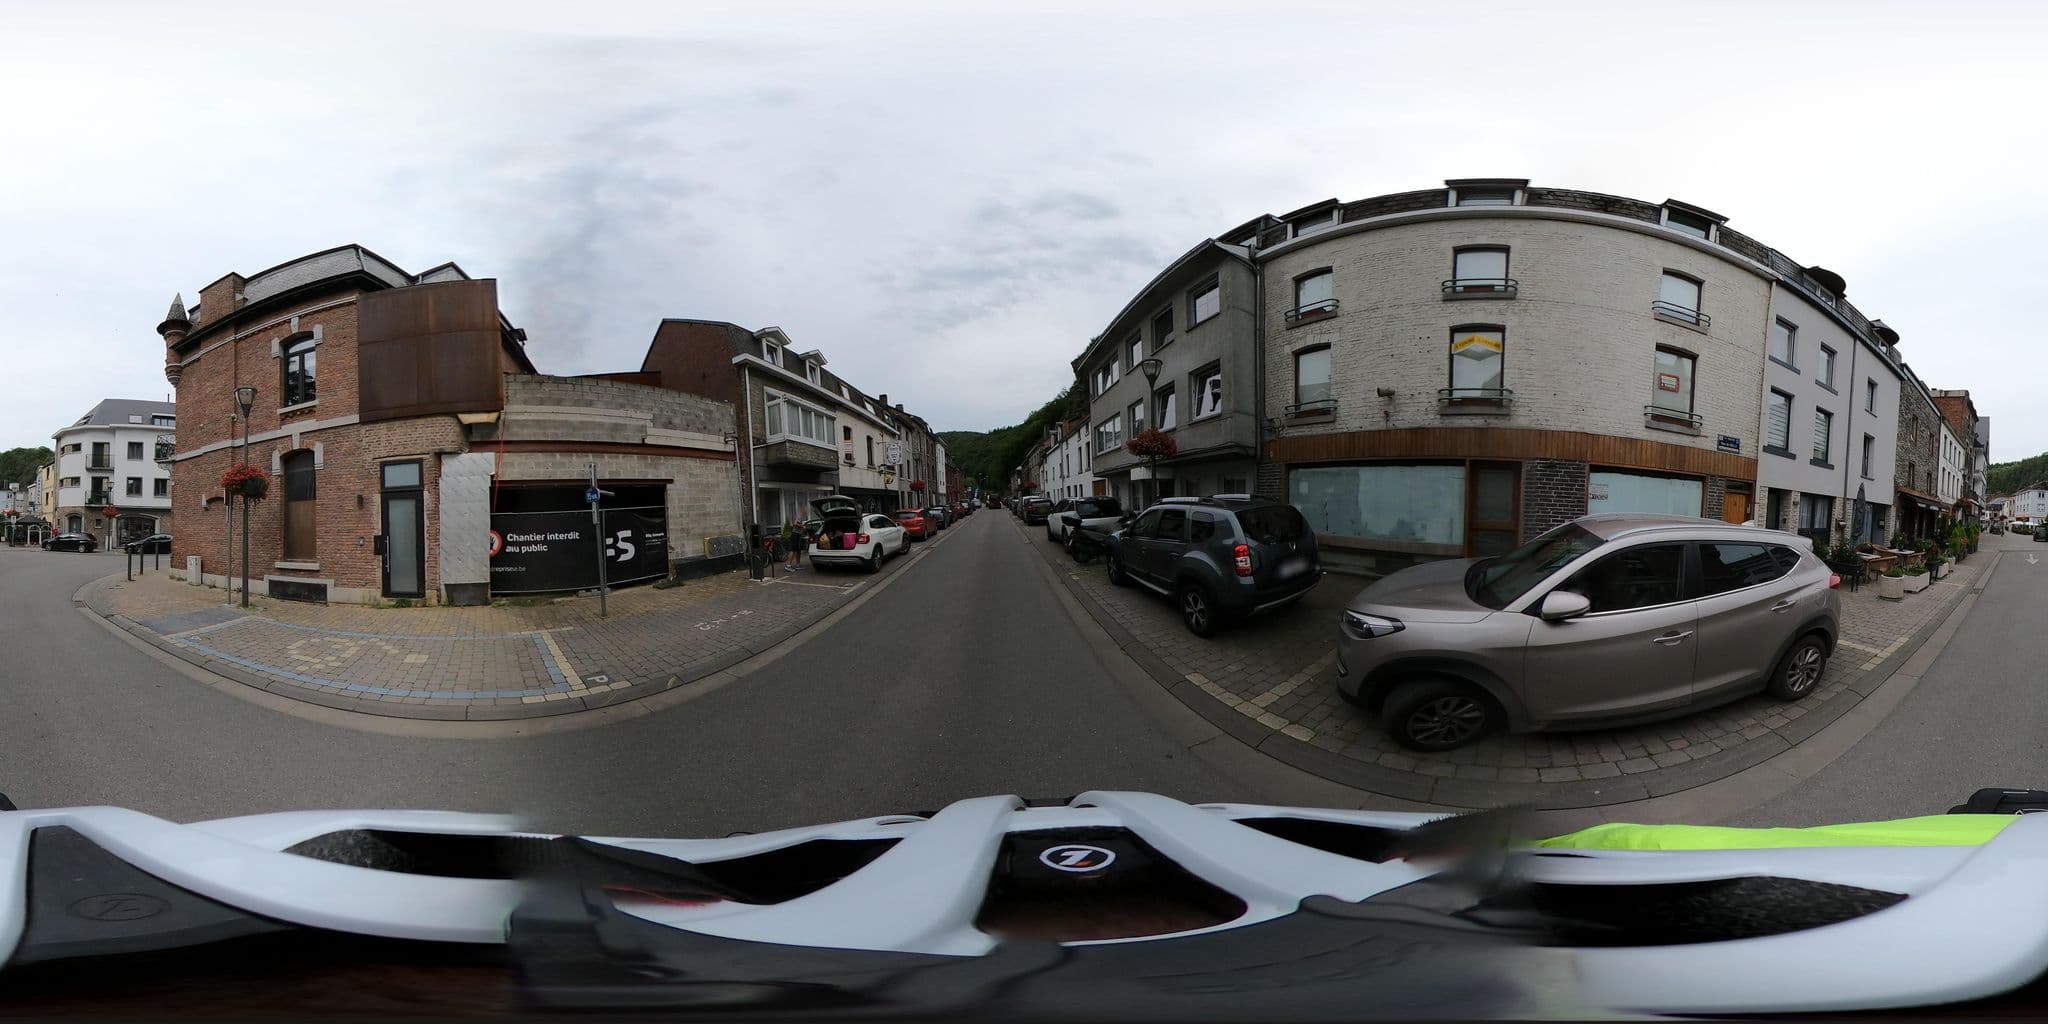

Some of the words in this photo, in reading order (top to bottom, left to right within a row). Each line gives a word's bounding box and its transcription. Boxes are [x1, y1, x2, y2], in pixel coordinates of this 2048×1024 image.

[507, 533, 545, 542] Chantier
[547, 531, 580, 541] interdit
[505, 545, 520, 553] au
[521, 544, 548, 554] public
